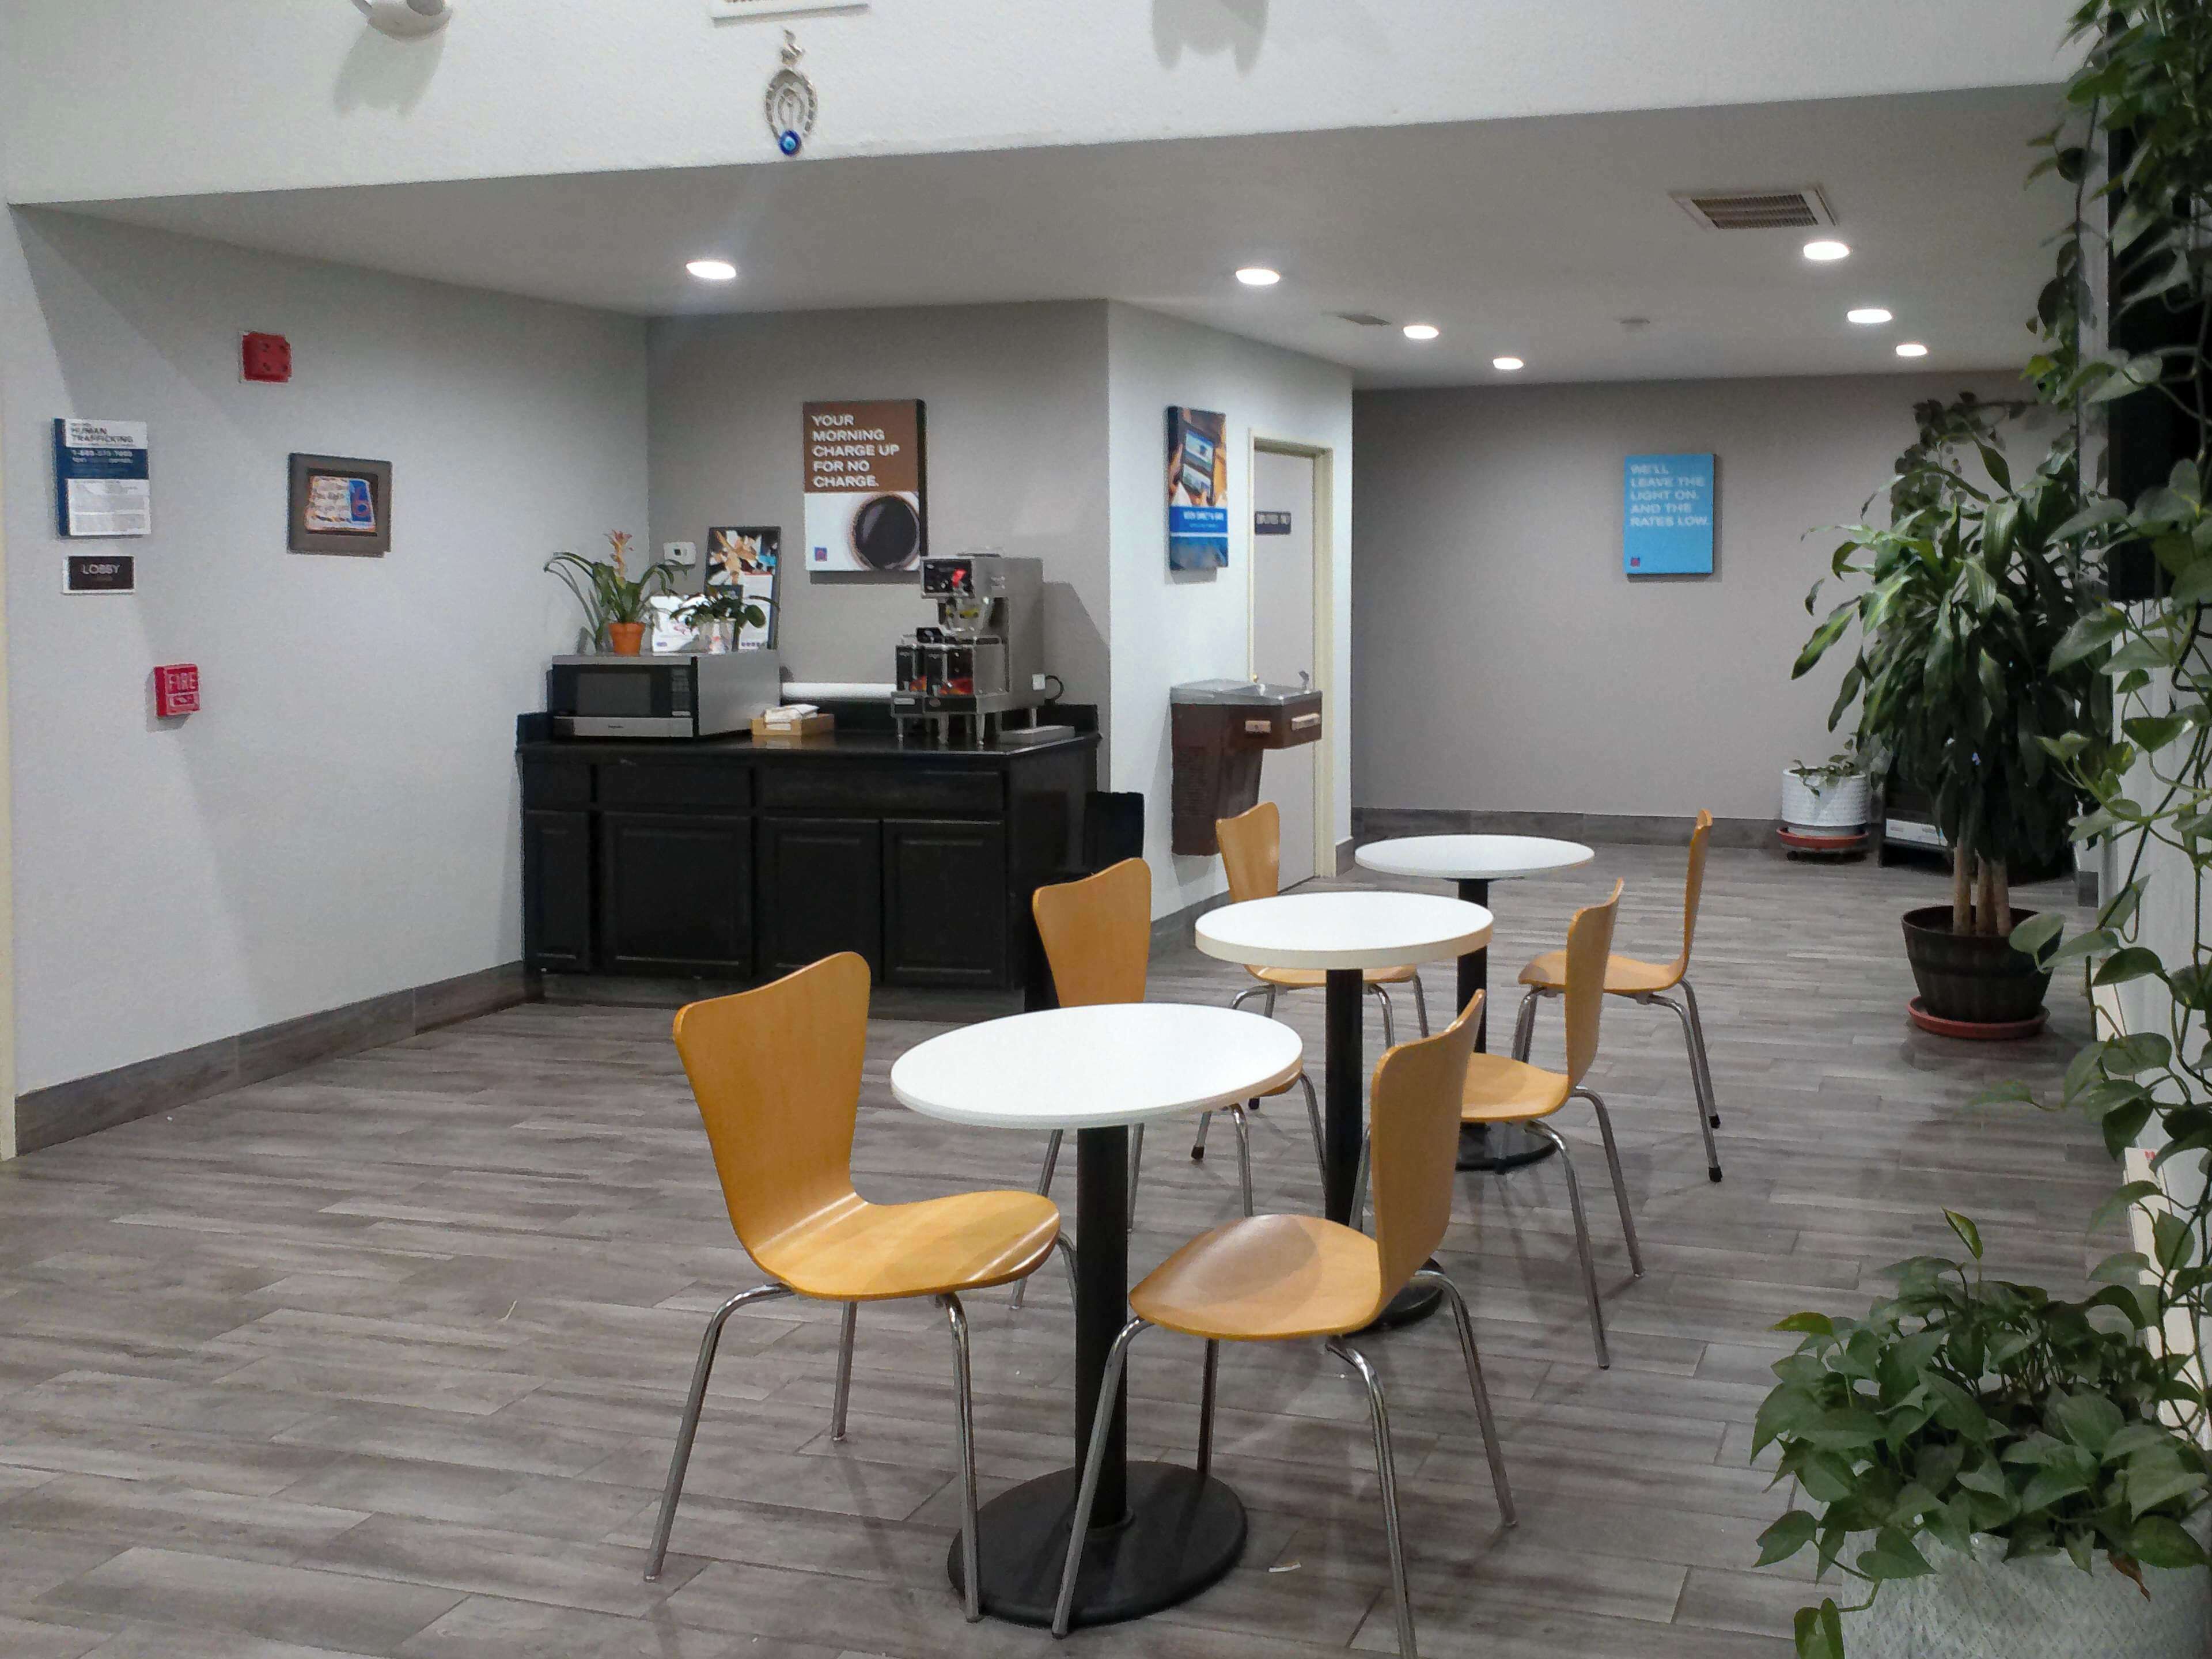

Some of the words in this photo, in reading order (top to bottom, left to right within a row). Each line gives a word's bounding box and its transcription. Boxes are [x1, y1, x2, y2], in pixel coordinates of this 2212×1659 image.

[811, 414, 854, 426] YOUR
[71, 434, 134, 443] TRAFFICKING
[812, 429, 885, 441] MORNING
[812, 445, 875, 457] CHARGE
[878, 444, 900, 456] UP
[813, 460, 844, 472] FOR
[848, 460, 870, 472] NO
[1631, 464, 1669, 474] WE'LL
[814, 475, 880, 487] CHARGE.
[1631, 477, 1673, 487] LEAVE
[1679, 476, 1705, 487] THE
[1631, 491, 1670, 500] LIGHT
[1631, 503, 1661, 513] AND
[1666, 503, 1692, 513] THE
[1630, 516, 1674, 527] RATES
[81, 563, 120, 574] LOBBY
